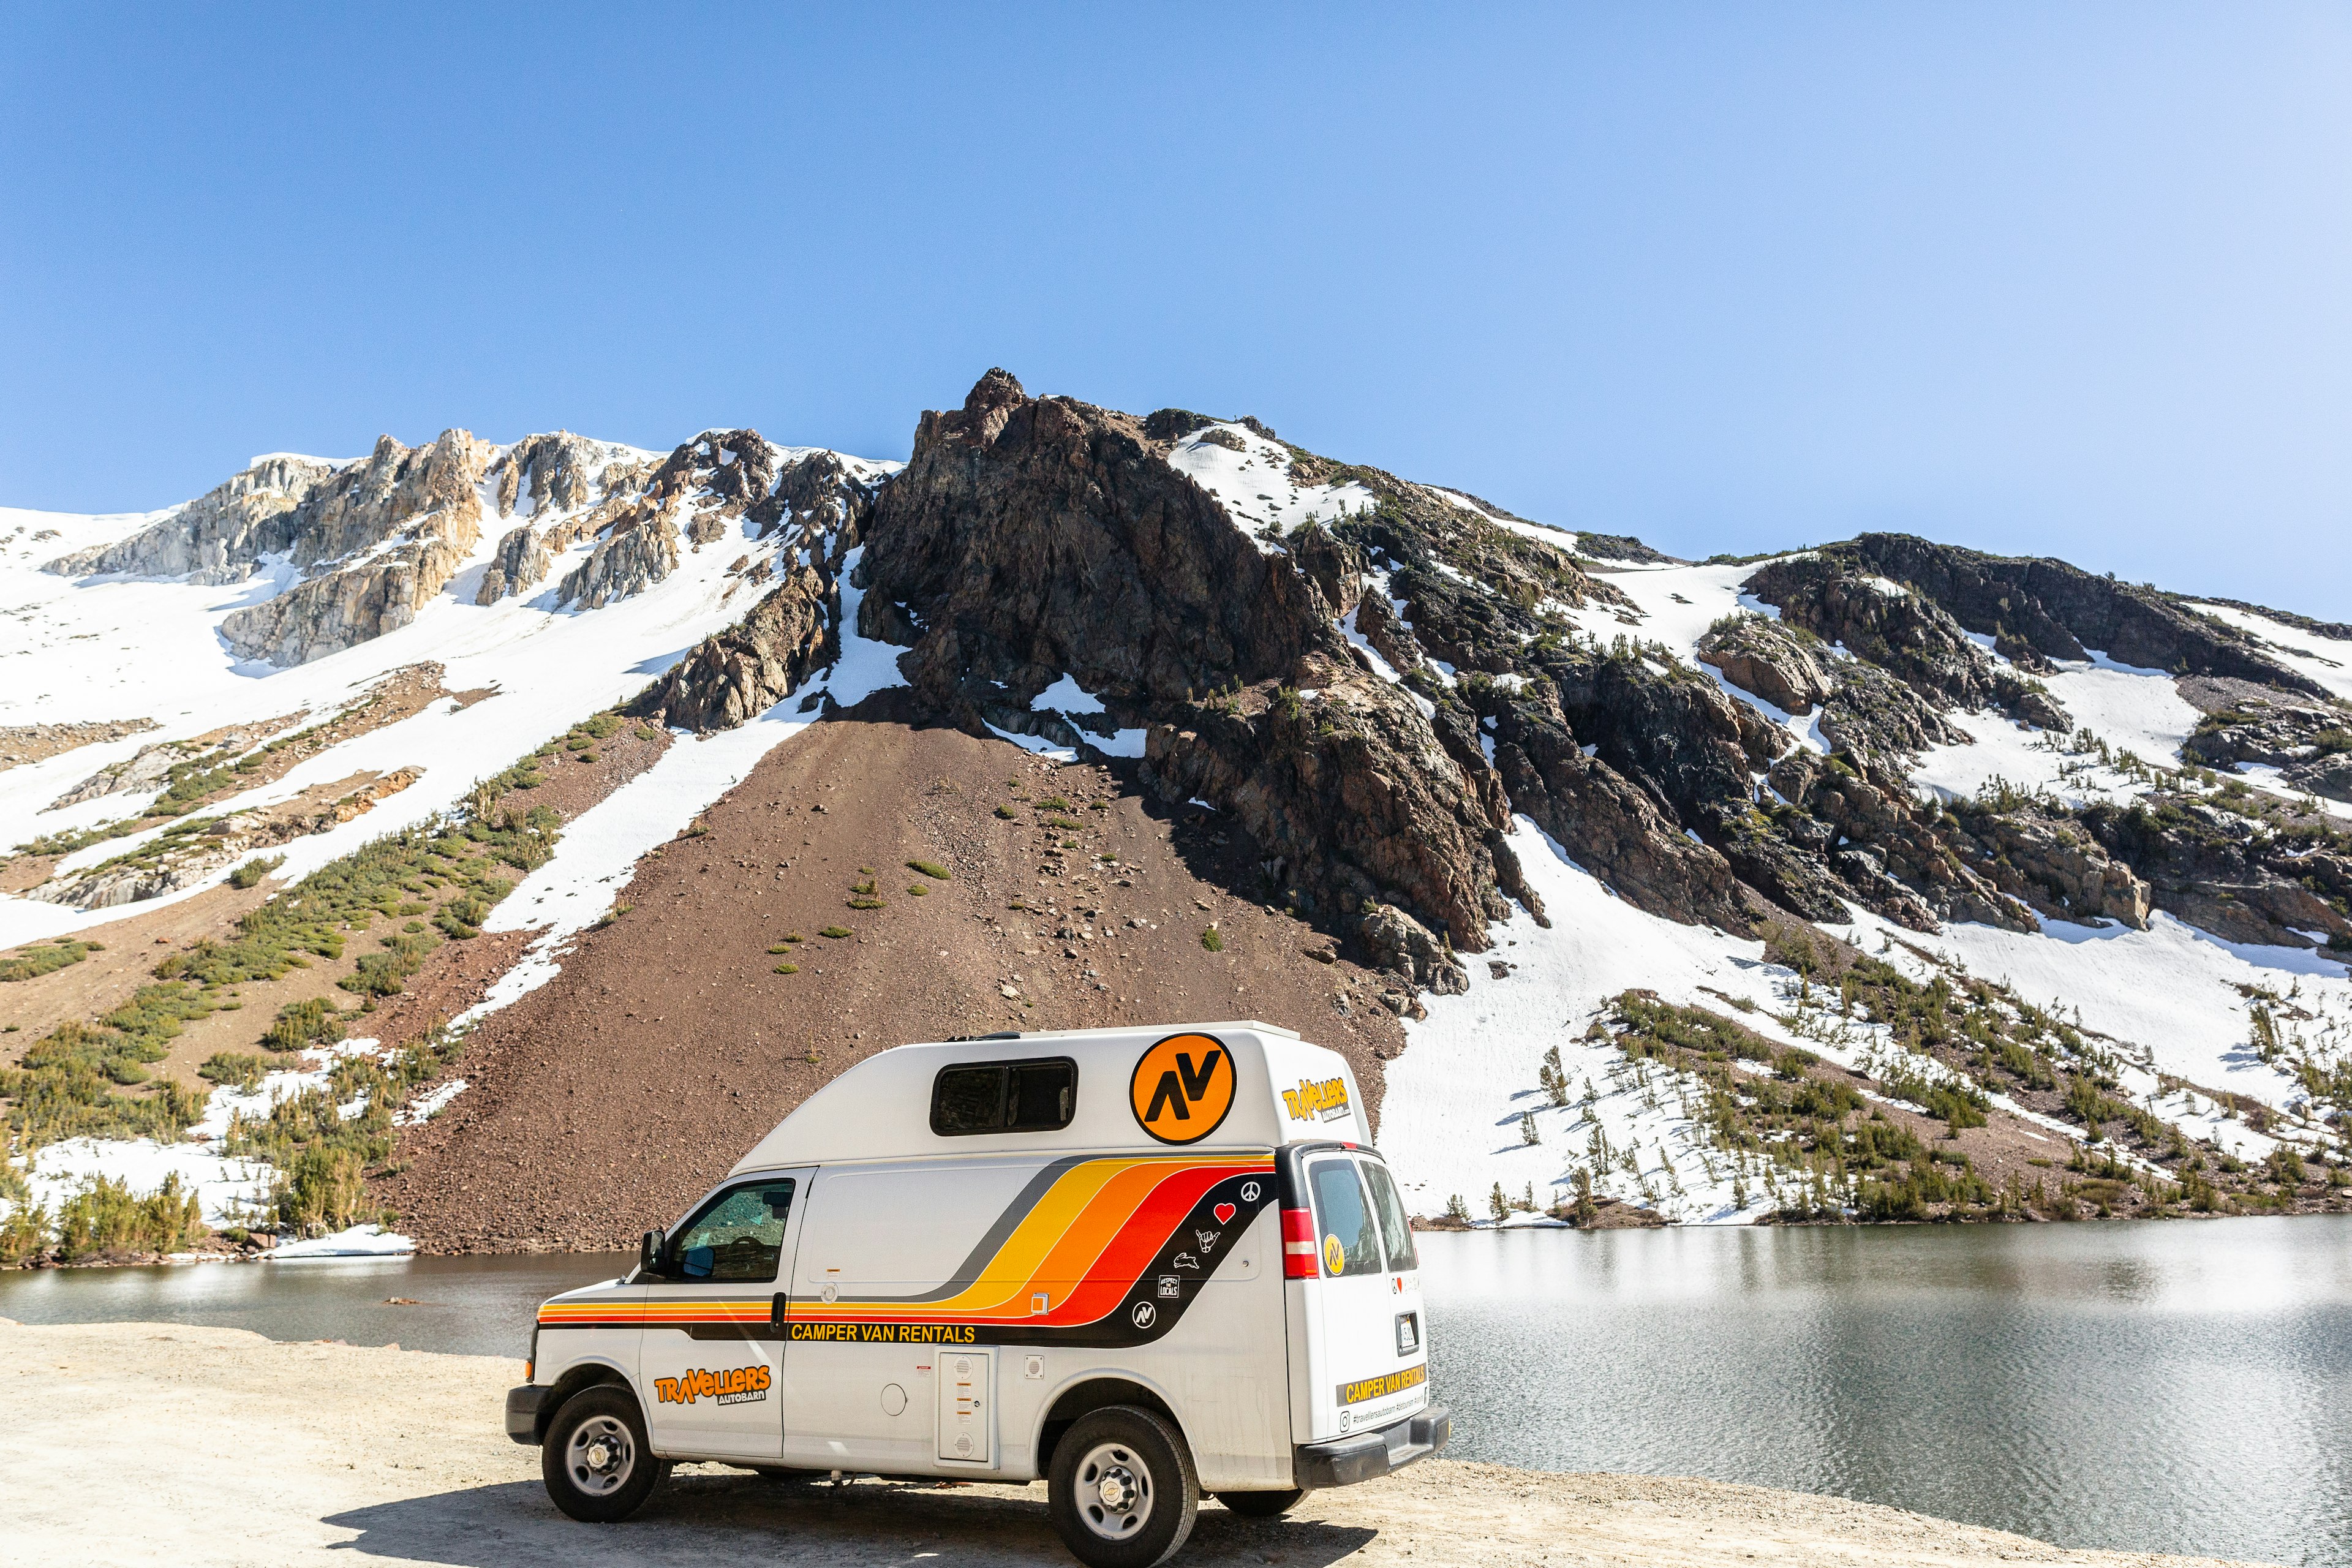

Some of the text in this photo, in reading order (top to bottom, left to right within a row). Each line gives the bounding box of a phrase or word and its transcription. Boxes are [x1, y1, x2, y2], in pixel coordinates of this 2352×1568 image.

[1160, 1286, 1177, 1295] LOCALS
[791, 1324, 975, 1343] CAMPER VAN RENTALS
[1346, 1365, 1425, 1403] CAMPER VAN RENTALS
[1353, 1406, 1395, 1425] #travellersautobarn
